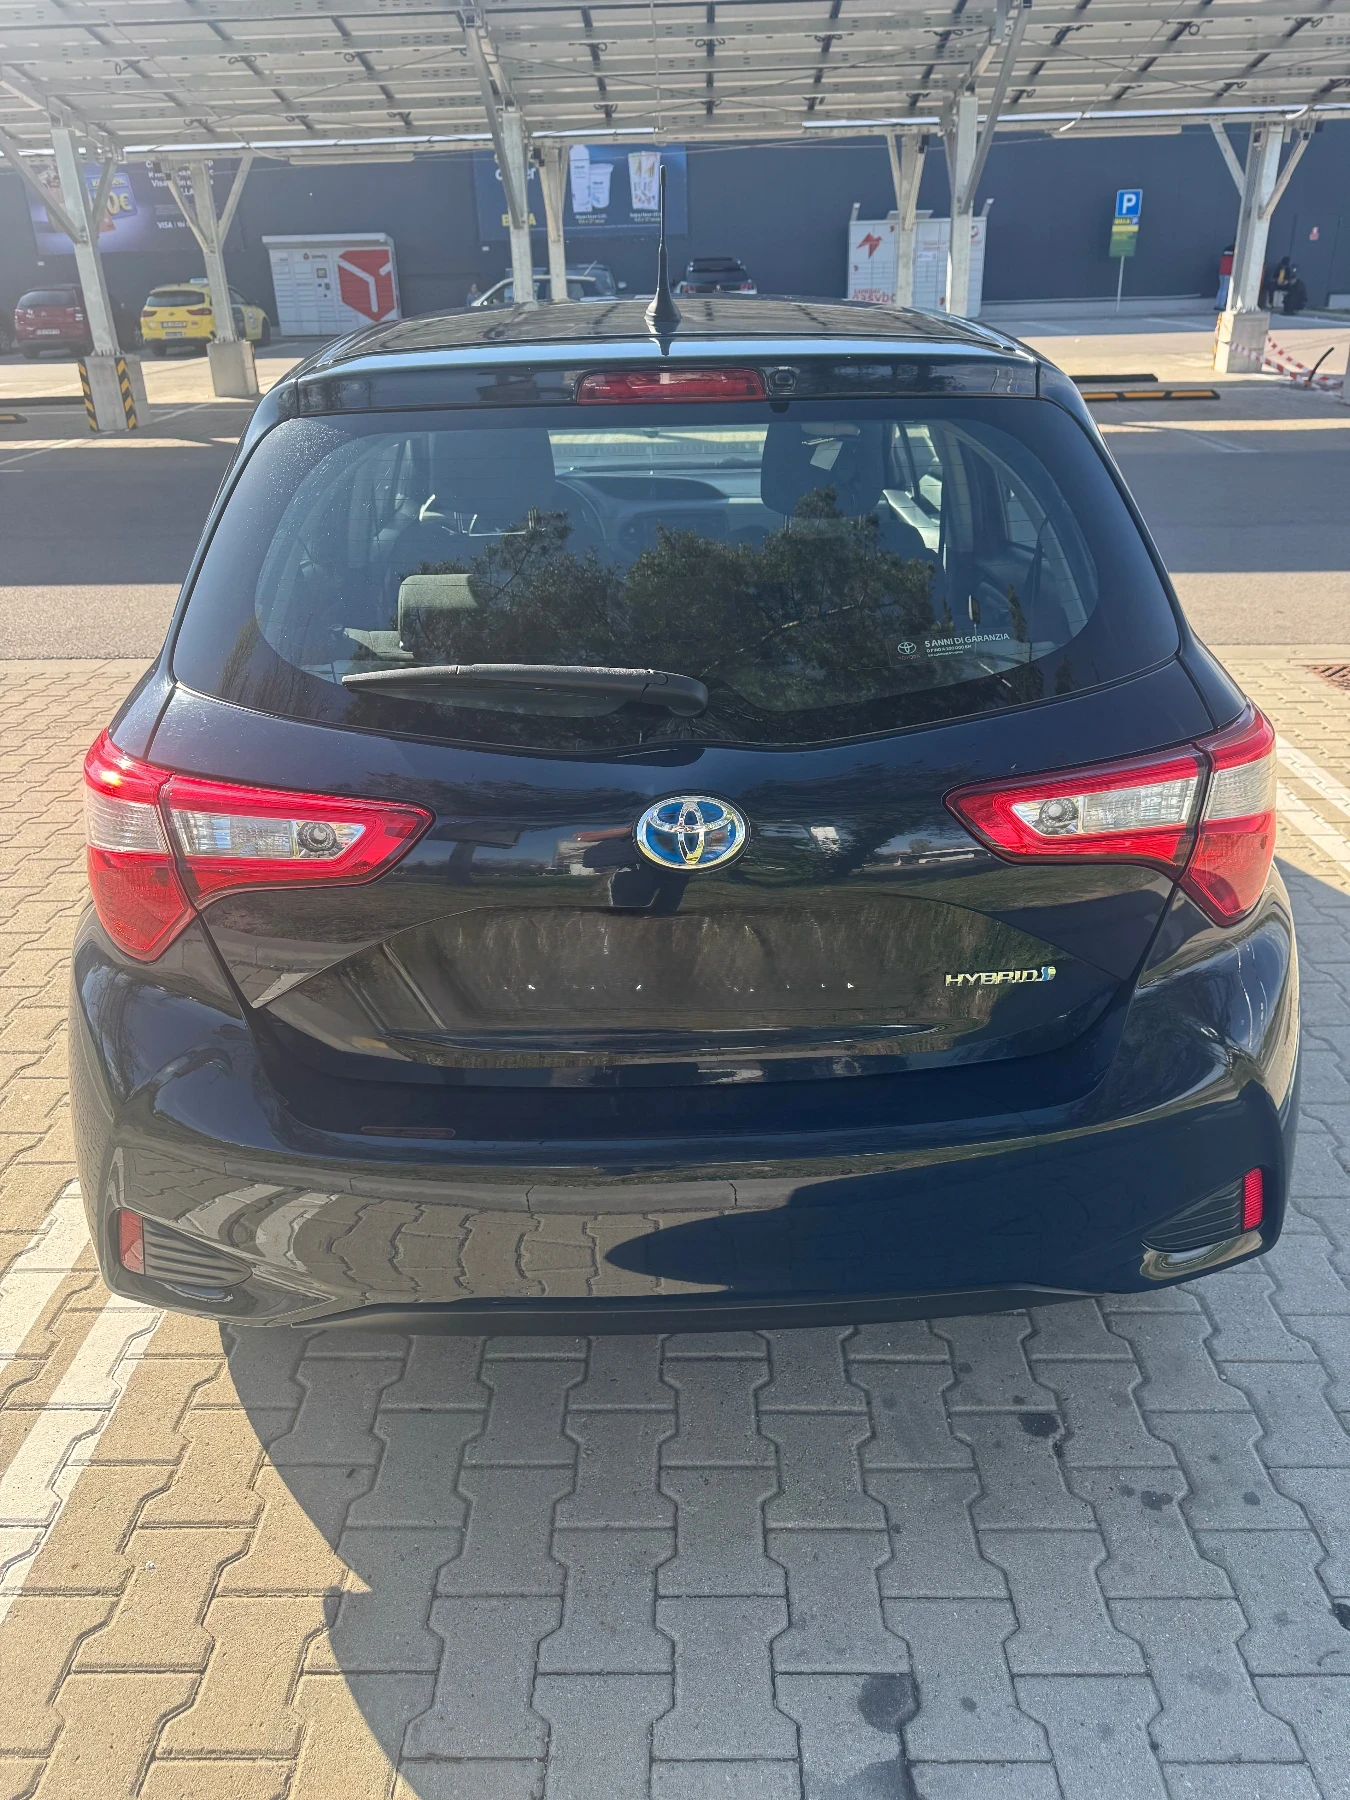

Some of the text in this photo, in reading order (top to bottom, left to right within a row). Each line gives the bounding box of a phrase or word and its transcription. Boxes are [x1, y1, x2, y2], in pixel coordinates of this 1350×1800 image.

[1122, 193, 1137, 214] P
[931, 638, 954, 647] ANNI
[955, 636, 964, 645] DI
[964, 633, 1010, 643] GARANZIA
[945, 969, 1039, 987] HYBRID
